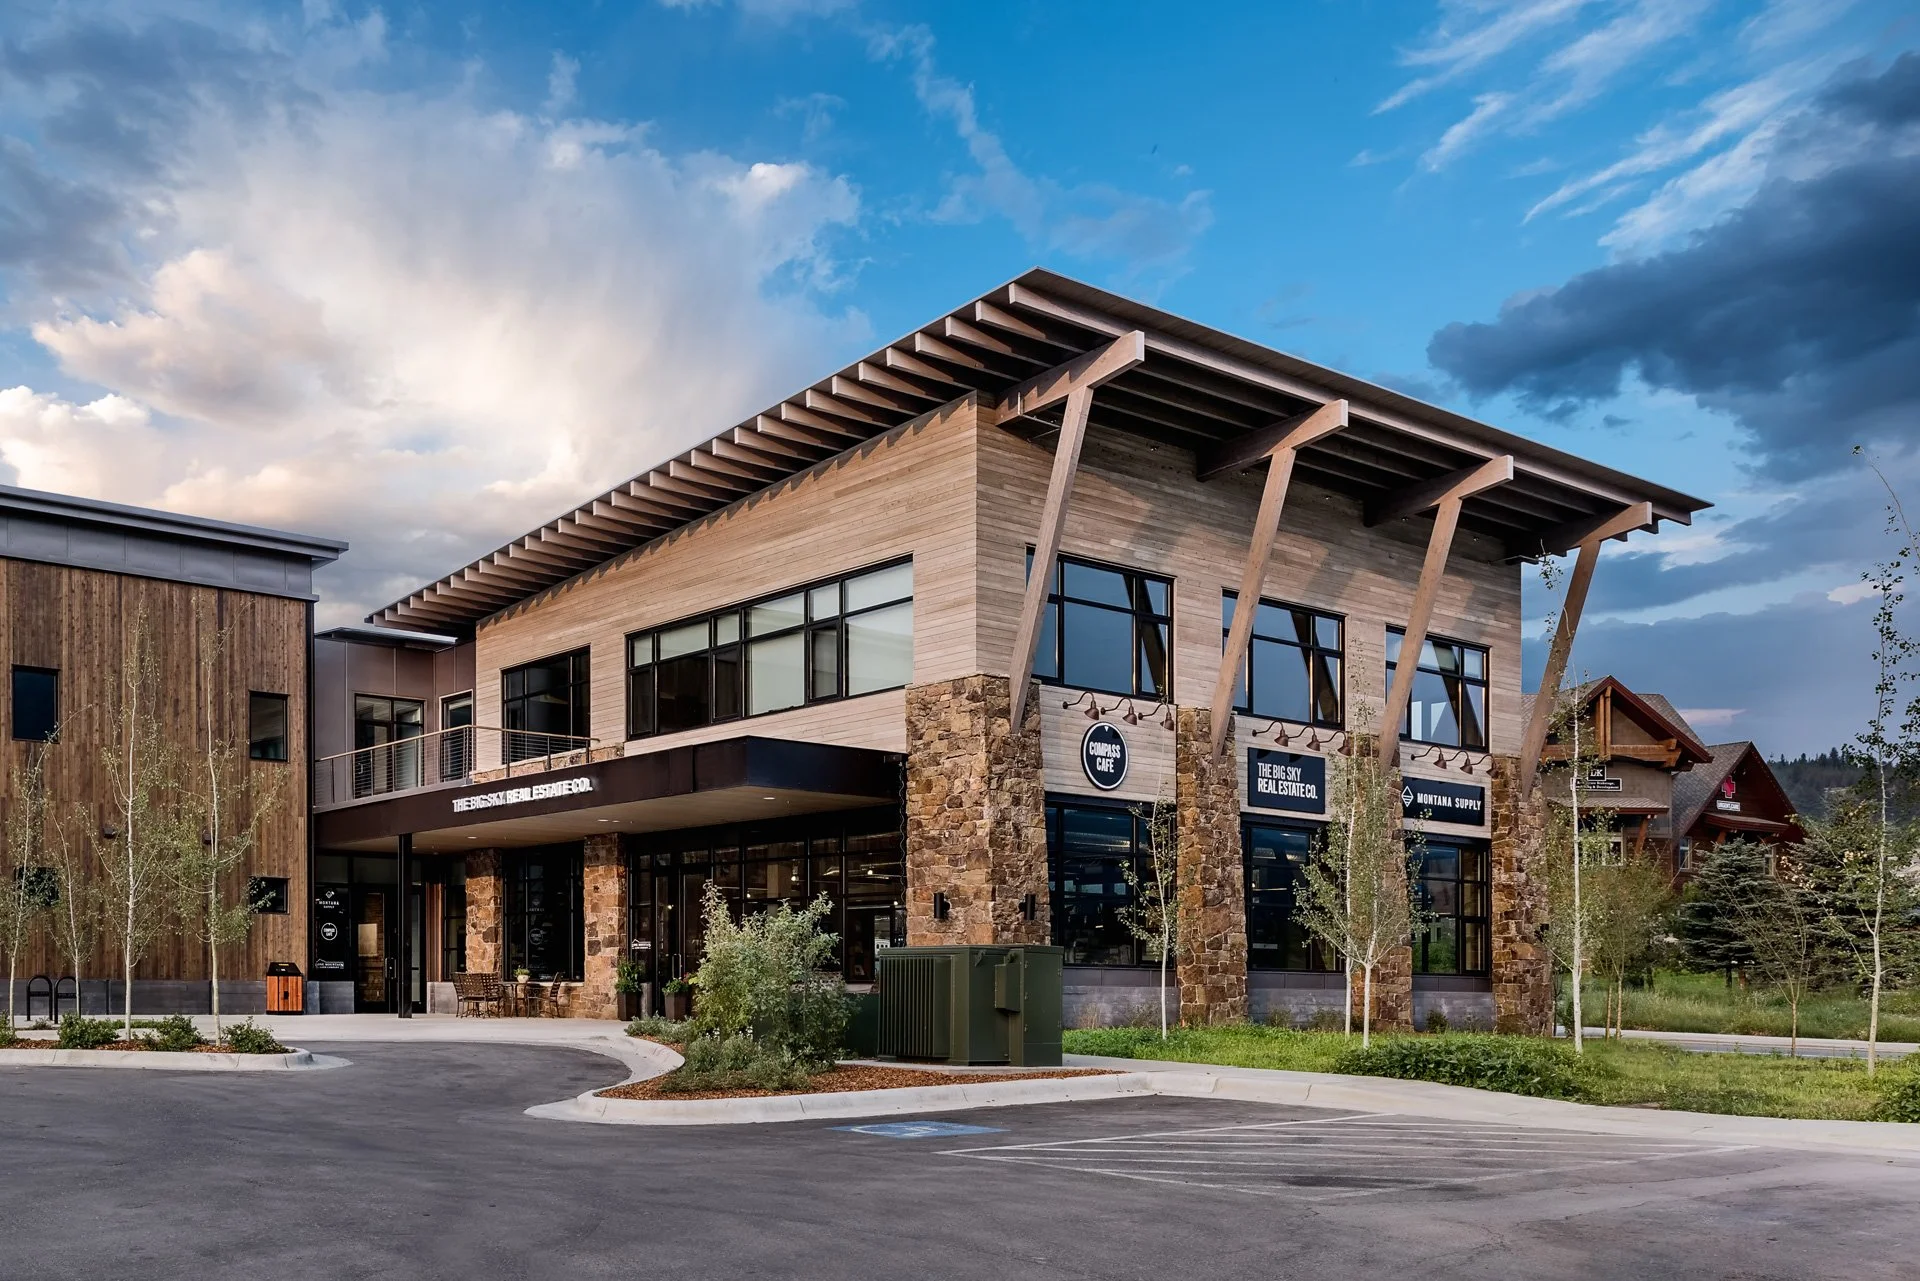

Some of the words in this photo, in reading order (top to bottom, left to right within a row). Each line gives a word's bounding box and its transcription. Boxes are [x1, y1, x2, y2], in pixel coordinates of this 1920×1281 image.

[1089, 741, 1120, 759] COMPASS
[1257, 762, 1272, 778] THE
[1272, 764, 1286, 780] BIG
[1286, 766, 1302, 782] SKY
[452, 797, 471, 812] THE
[470, 795, 488, 808] BIG
[506, 787, 534, 804] REAL
[532, 780, 573, 798] ESTATE
[1257, 778, 1278, 794] REAL
[1278, 781, 1305, 797] ESTATE
[1305, 783, 1318, 800] CO.
[1417, 793, 1452, 807] MONTANA
[1455, 798, 1481, 810] SUPPLY
